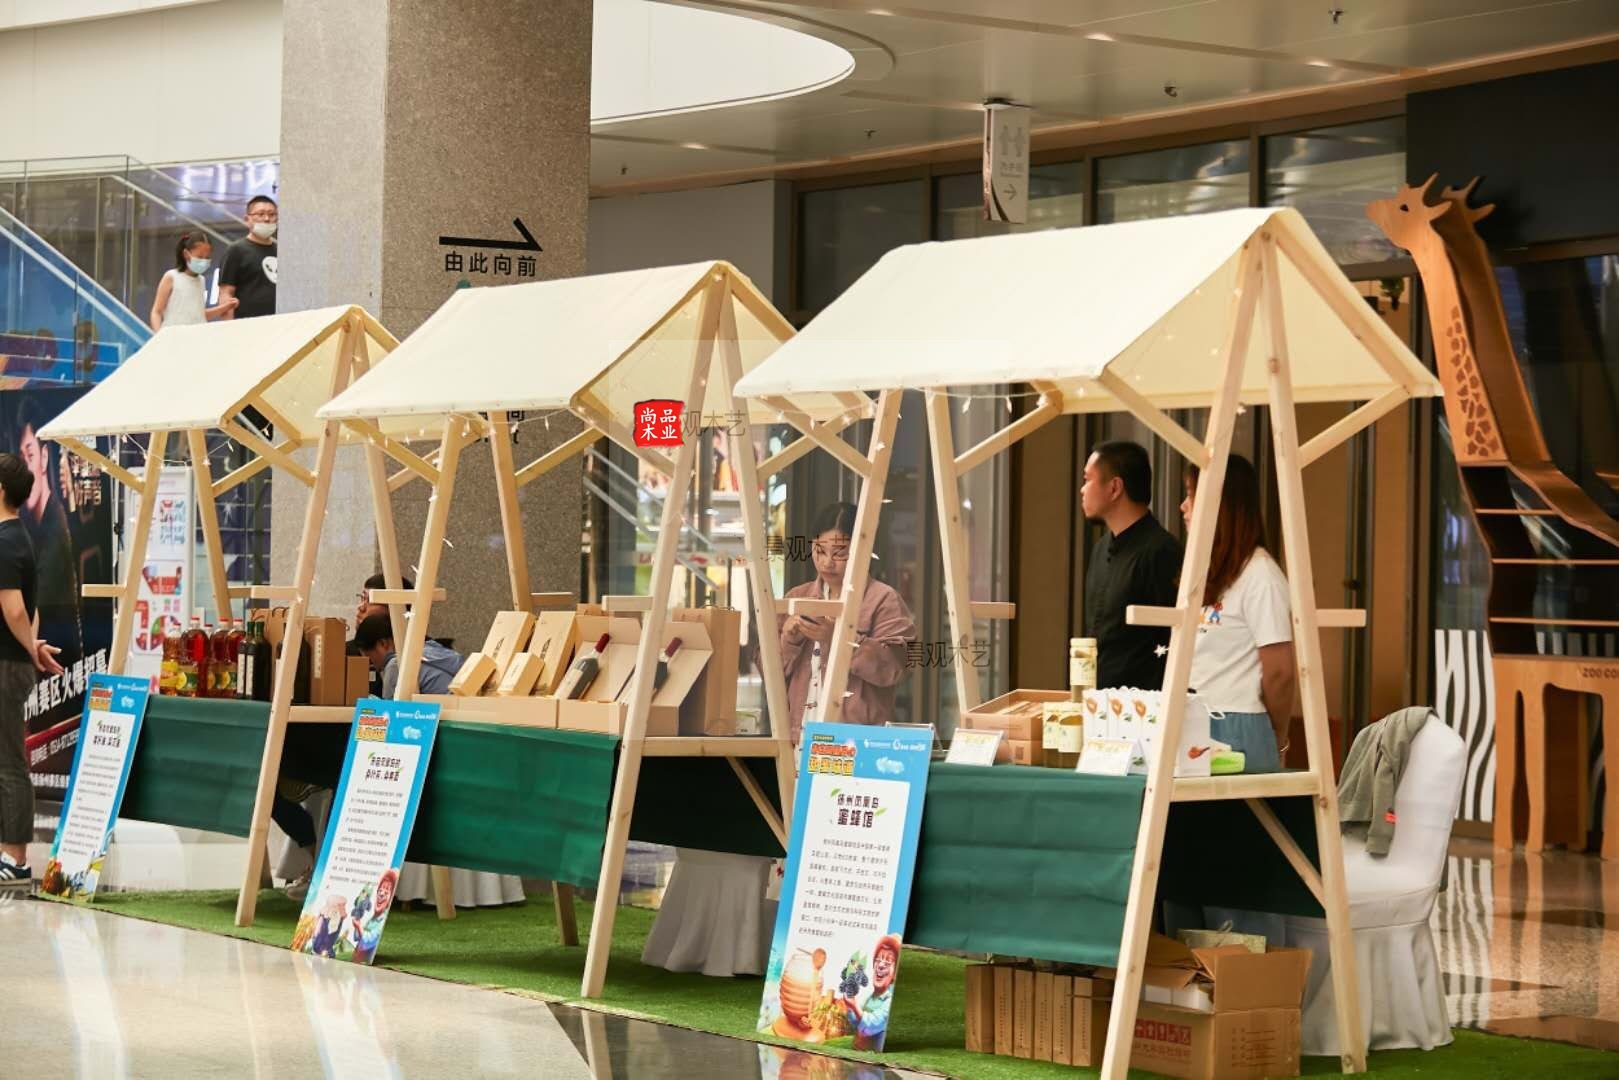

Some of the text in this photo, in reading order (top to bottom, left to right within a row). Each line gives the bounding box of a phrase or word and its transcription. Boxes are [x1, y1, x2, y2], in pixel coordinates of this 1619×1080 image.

[445, 250, 537, 277] 由此向前
[1604, 667, 1619, 679] CO
